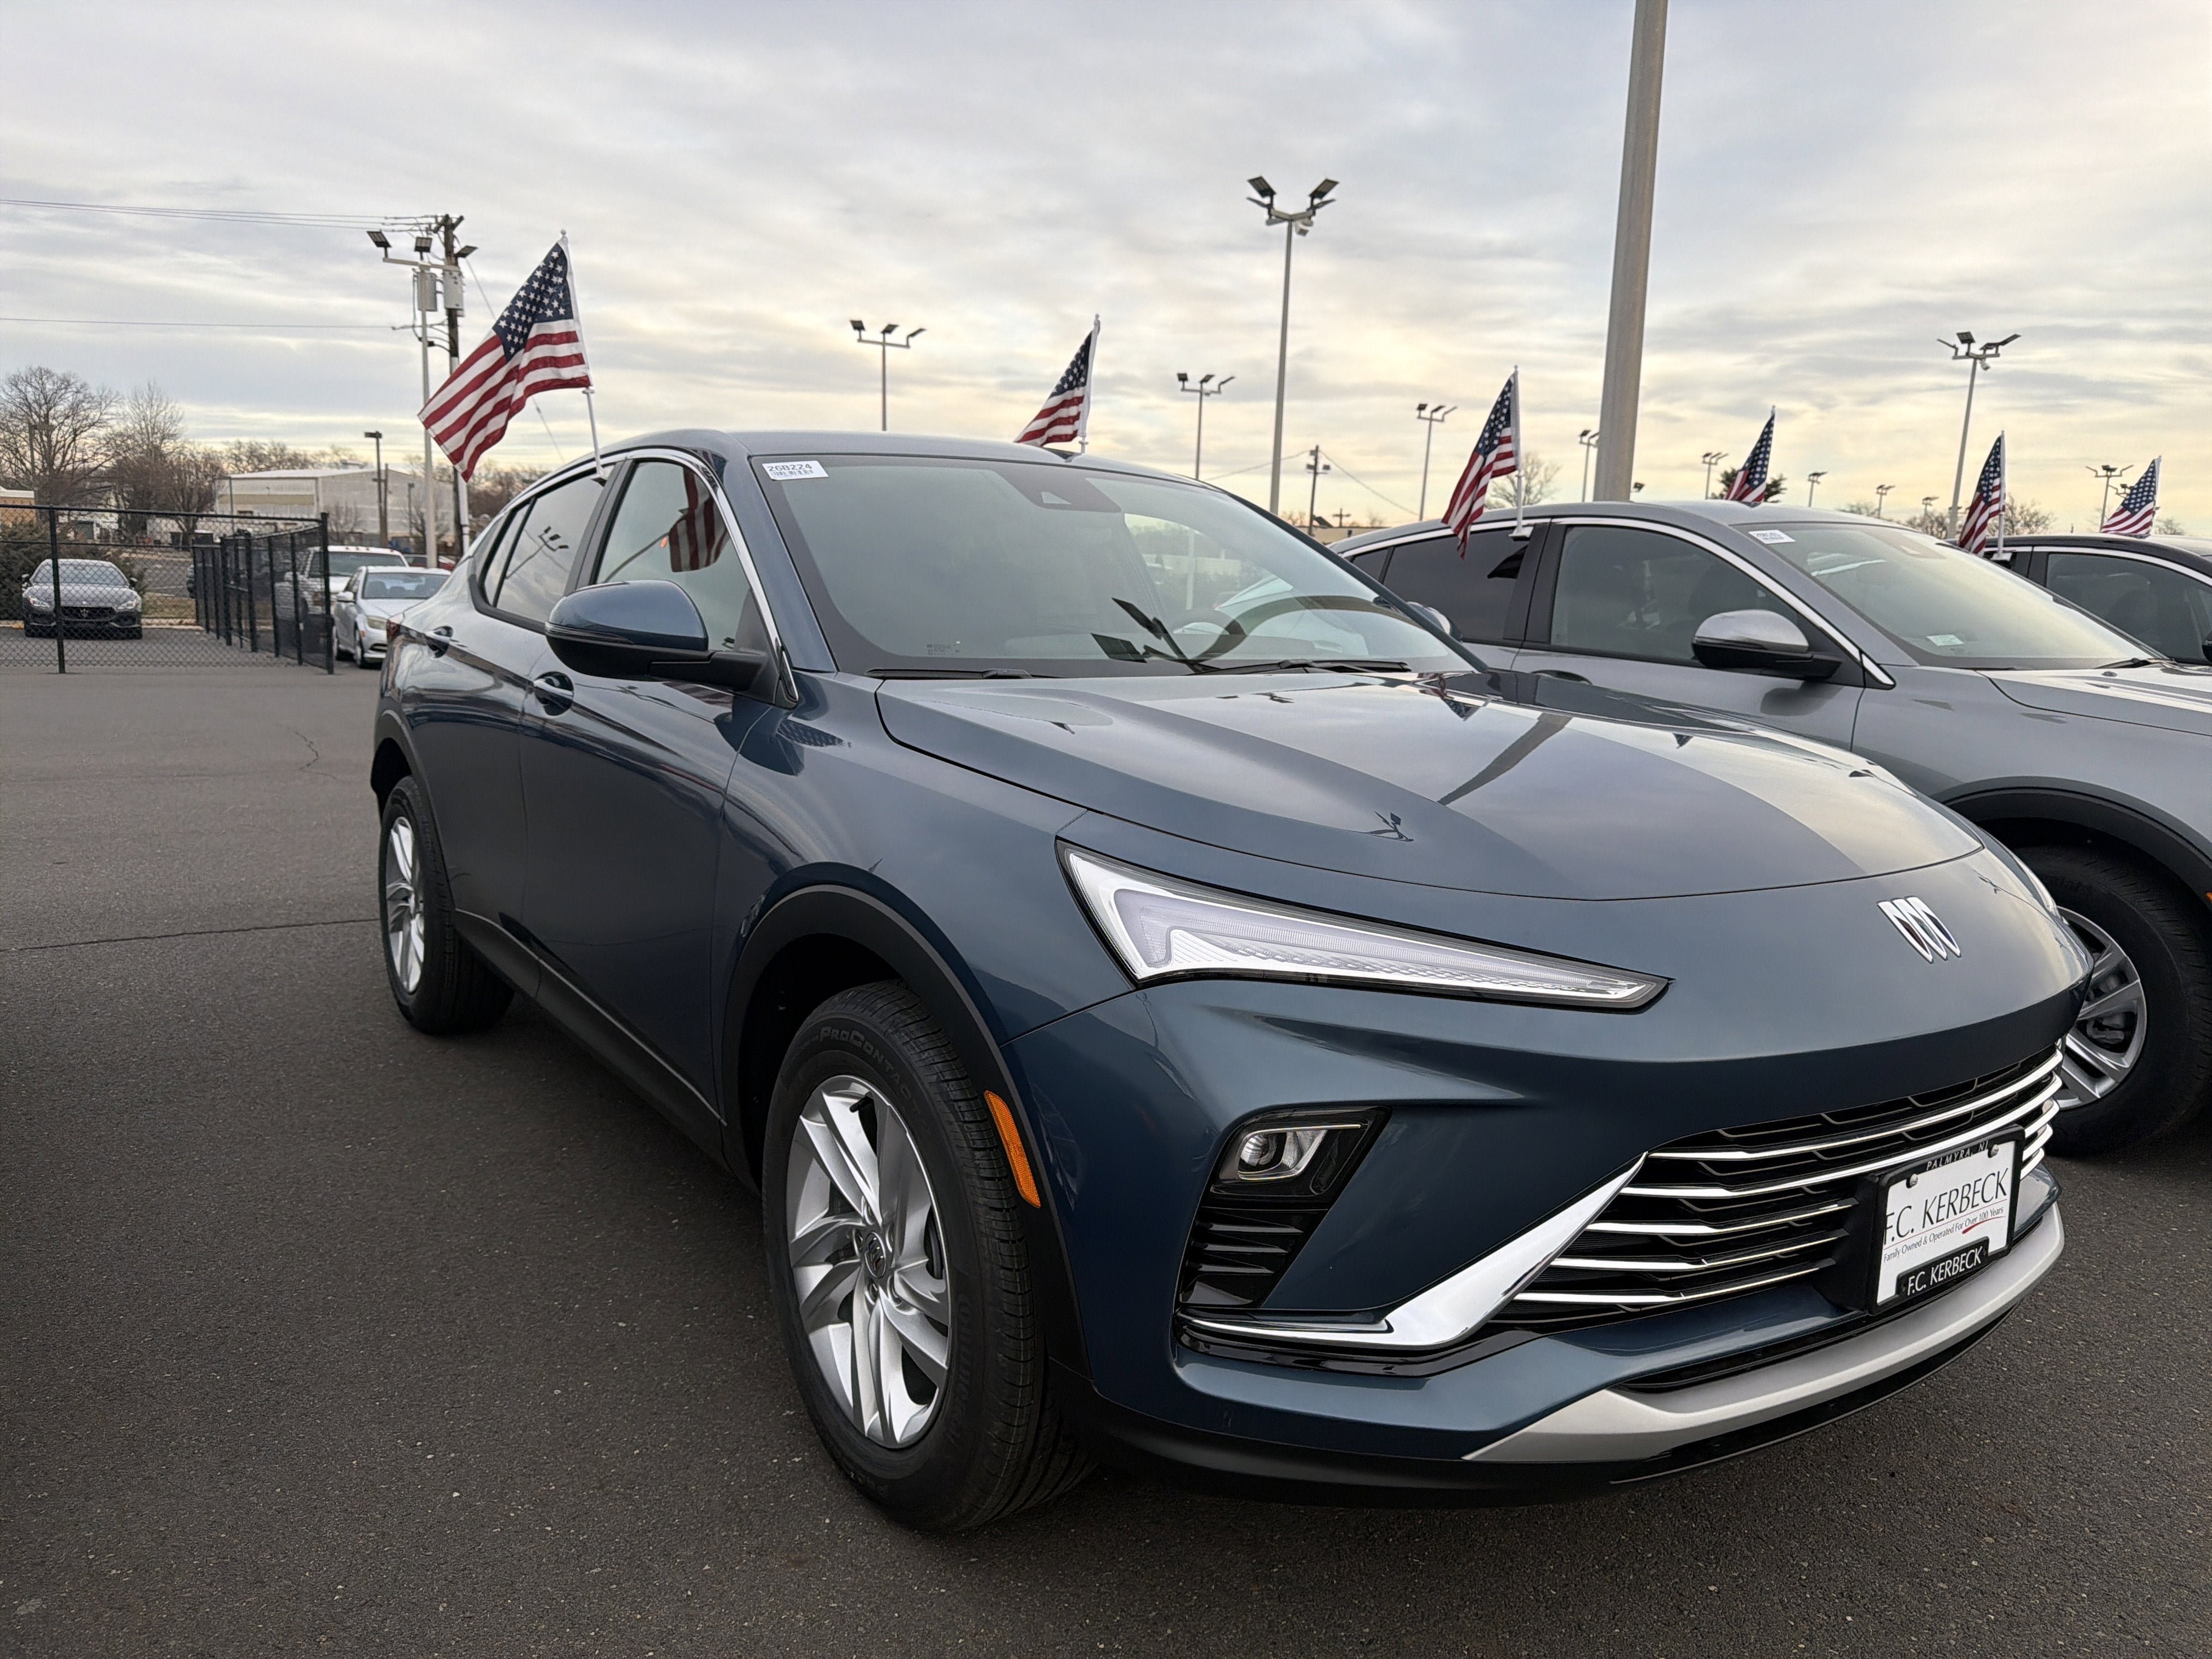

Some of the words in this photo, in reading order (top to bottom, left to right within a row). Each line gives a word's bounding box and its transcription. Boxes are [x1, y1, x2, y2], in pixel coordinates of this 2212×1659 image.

[1922, 1167, 2009, 1229] KERBECK
[1883, 1247, 1901, 1263] Family
[1901, 1237, 1923, 1254] Owned
[1923, 1236, 1928, 1245] &
[1929, 1223, 1955, 1243] Operated
[1955, 1222, 1964, 1232] For
[1965, 1216, 1978, 1227] Over
[1979, 1210, 1989, 1222] 100
[1990, 1206, 2004, 1217] Years
[1907, 1271, 1927, 1296] F.C.
[1930, 1245, 1983, 1286] KERBECK
